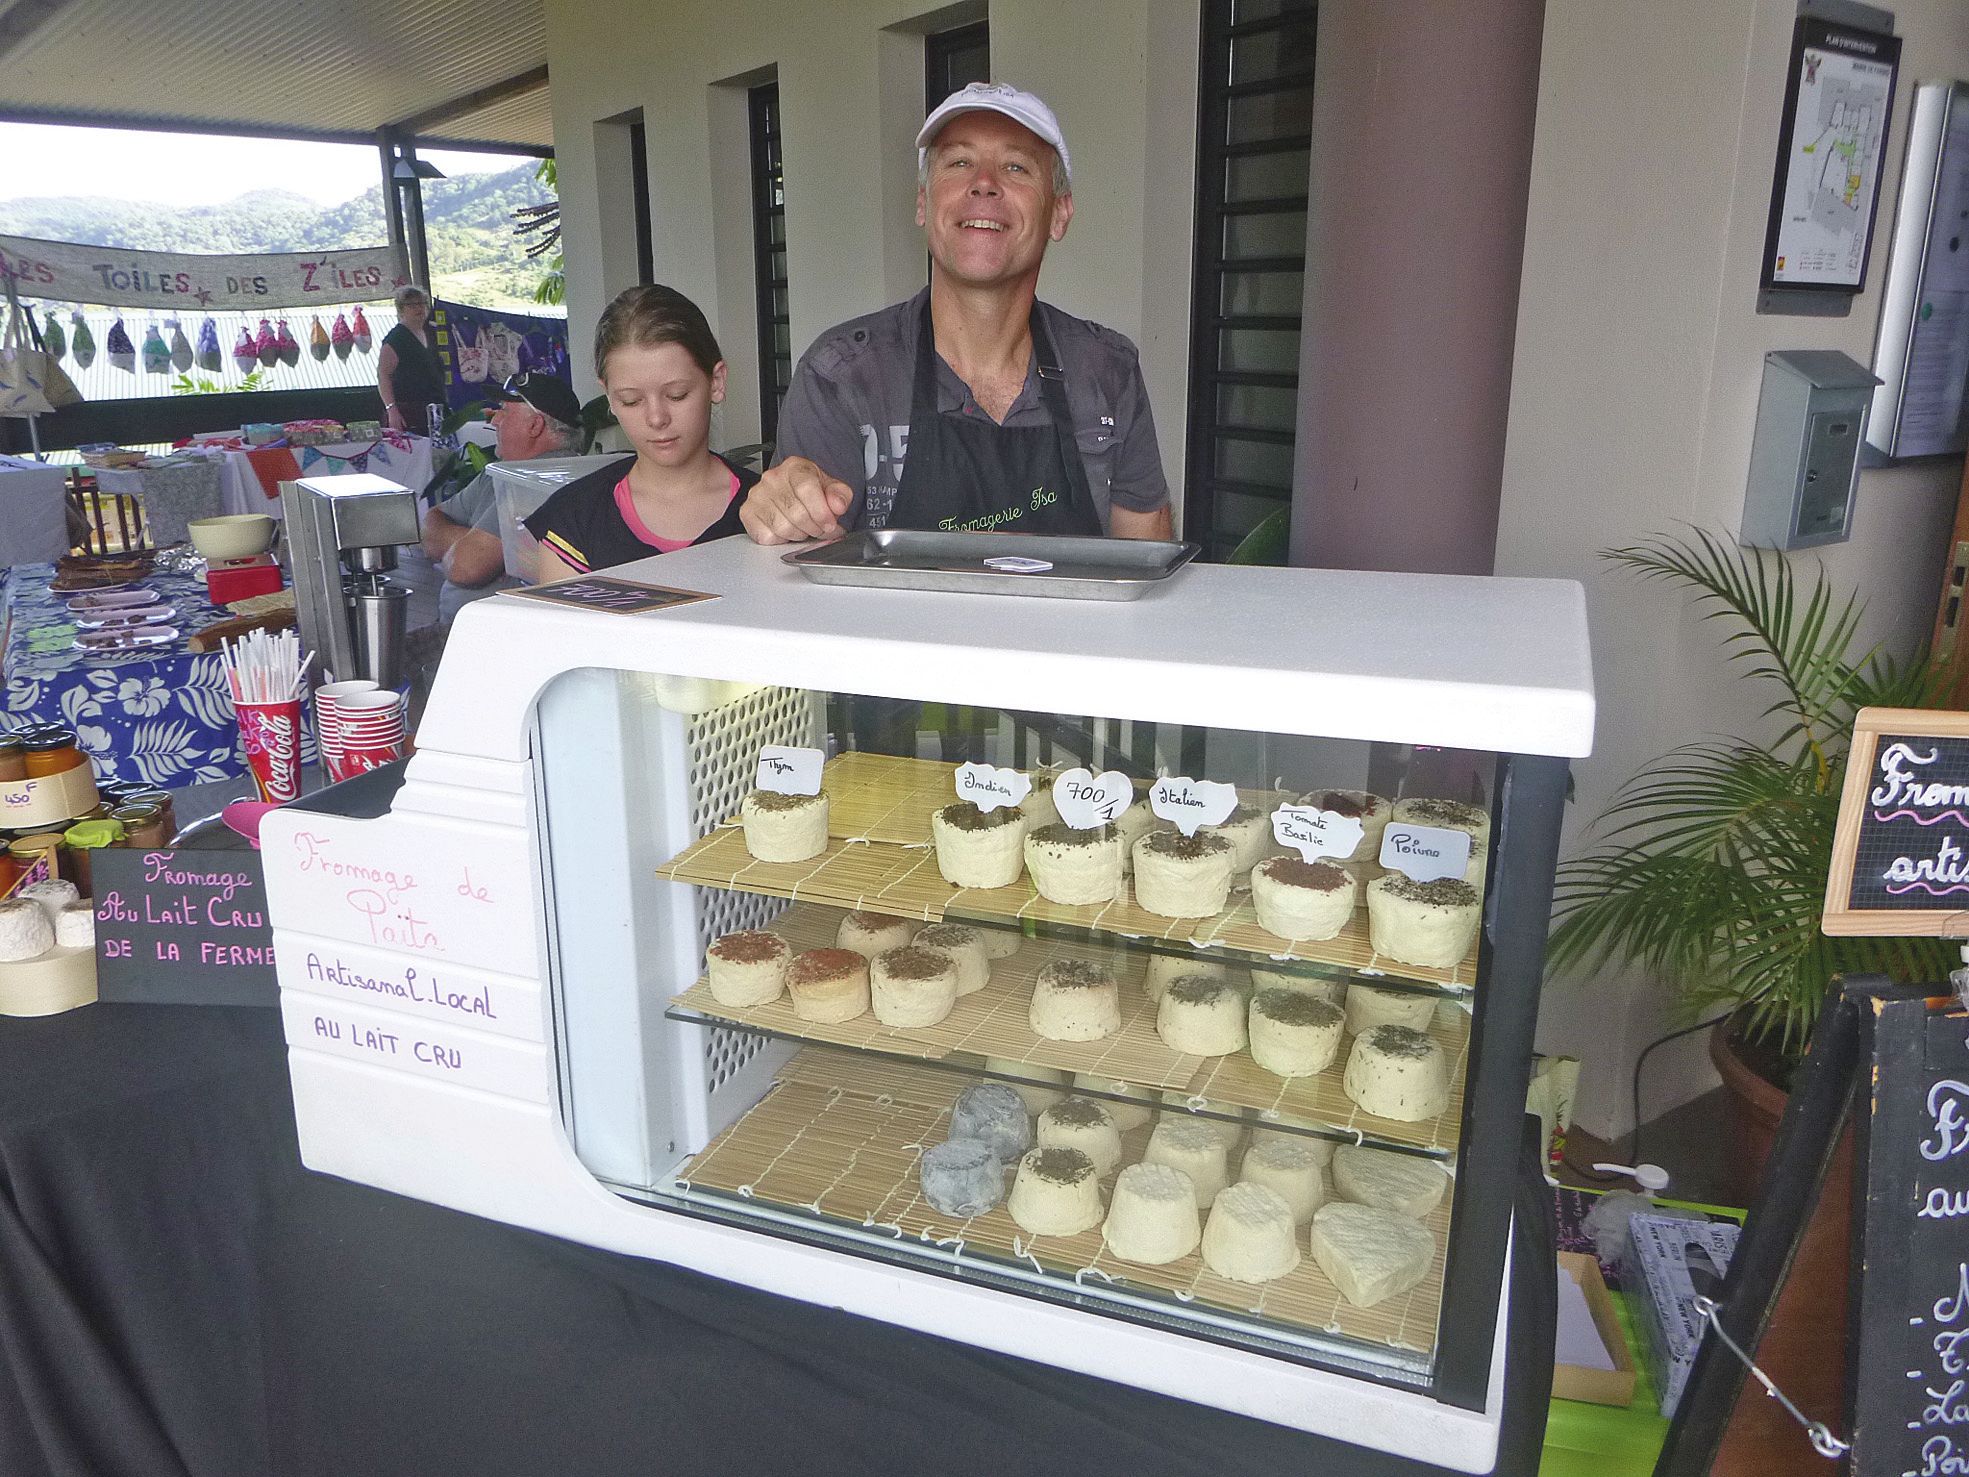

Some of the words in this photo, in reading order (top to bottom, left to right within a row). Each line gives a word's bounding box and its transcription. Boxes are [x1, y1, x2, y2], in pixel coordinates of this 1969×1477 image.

[226, 276, 268, 296] DES
[938, 507, 1023, 532] Fromagerie
[1030, 486, 1058, 511] Isa
[760, 757, 795, 775] Thym
[964, 771, 1012, 797] Indien
[1158, 786, 1206, 808] Italien
[1280, 809, 1329, 830] Tomate
[1280, 822, 1324, 846] Basilic
[293, 831, 418, 905] Fromage
[457, 866, 495, 904] de
[104, 939, 133, 958] DE
[156, 941, 181, 962] LA
[200, 942, 276, 966] FERME
[313, 1016, 342, 1040] AU
[413, 1041, 463, 1070] CRU
